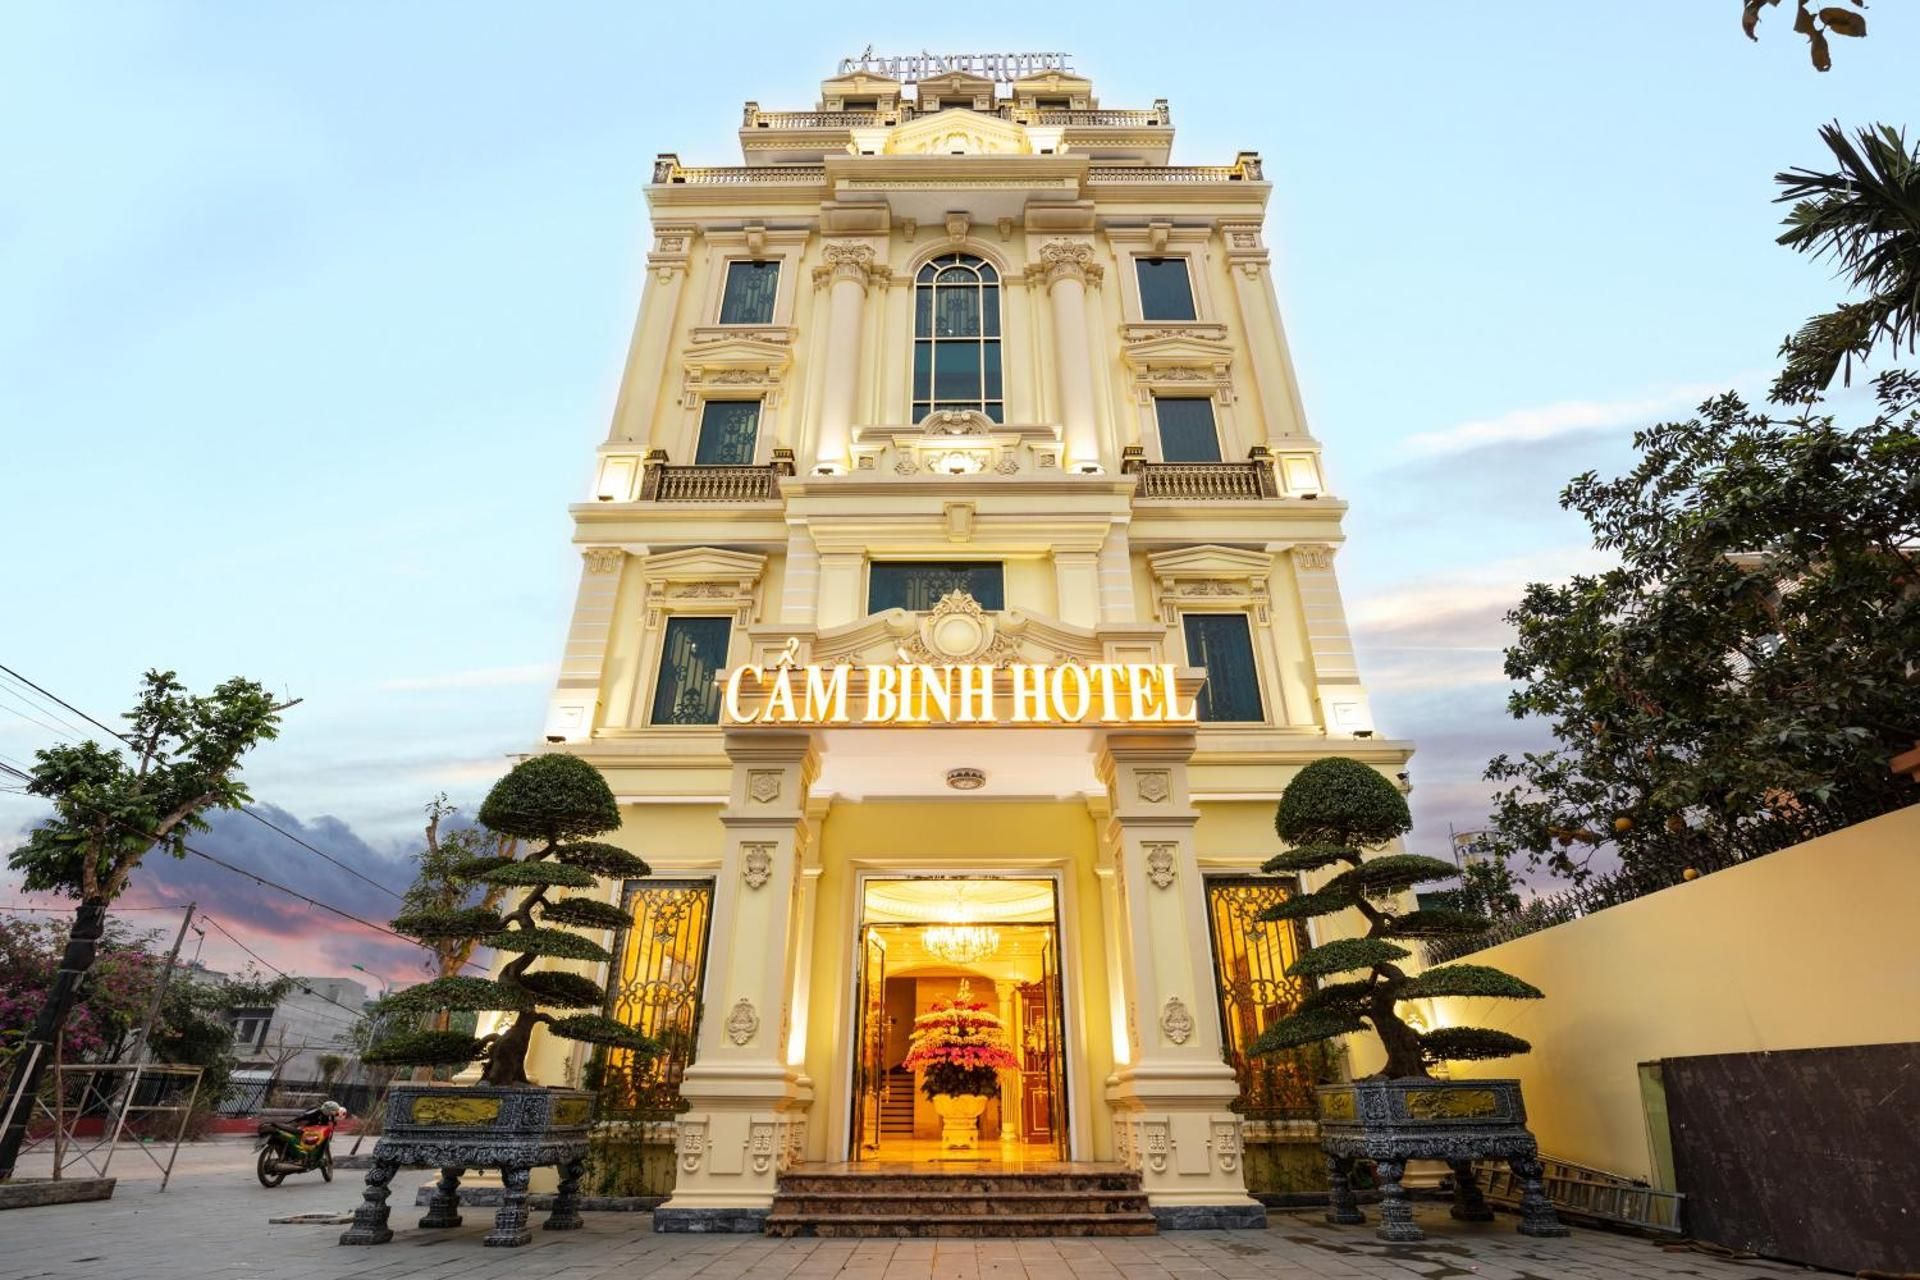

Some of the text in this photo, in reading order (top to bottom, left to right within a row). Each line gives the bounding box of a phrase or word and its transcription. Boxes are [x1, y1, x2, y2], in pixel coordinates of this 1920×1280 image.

[726, 637, 1197, 723] CẨM BÌNH HOTEL
